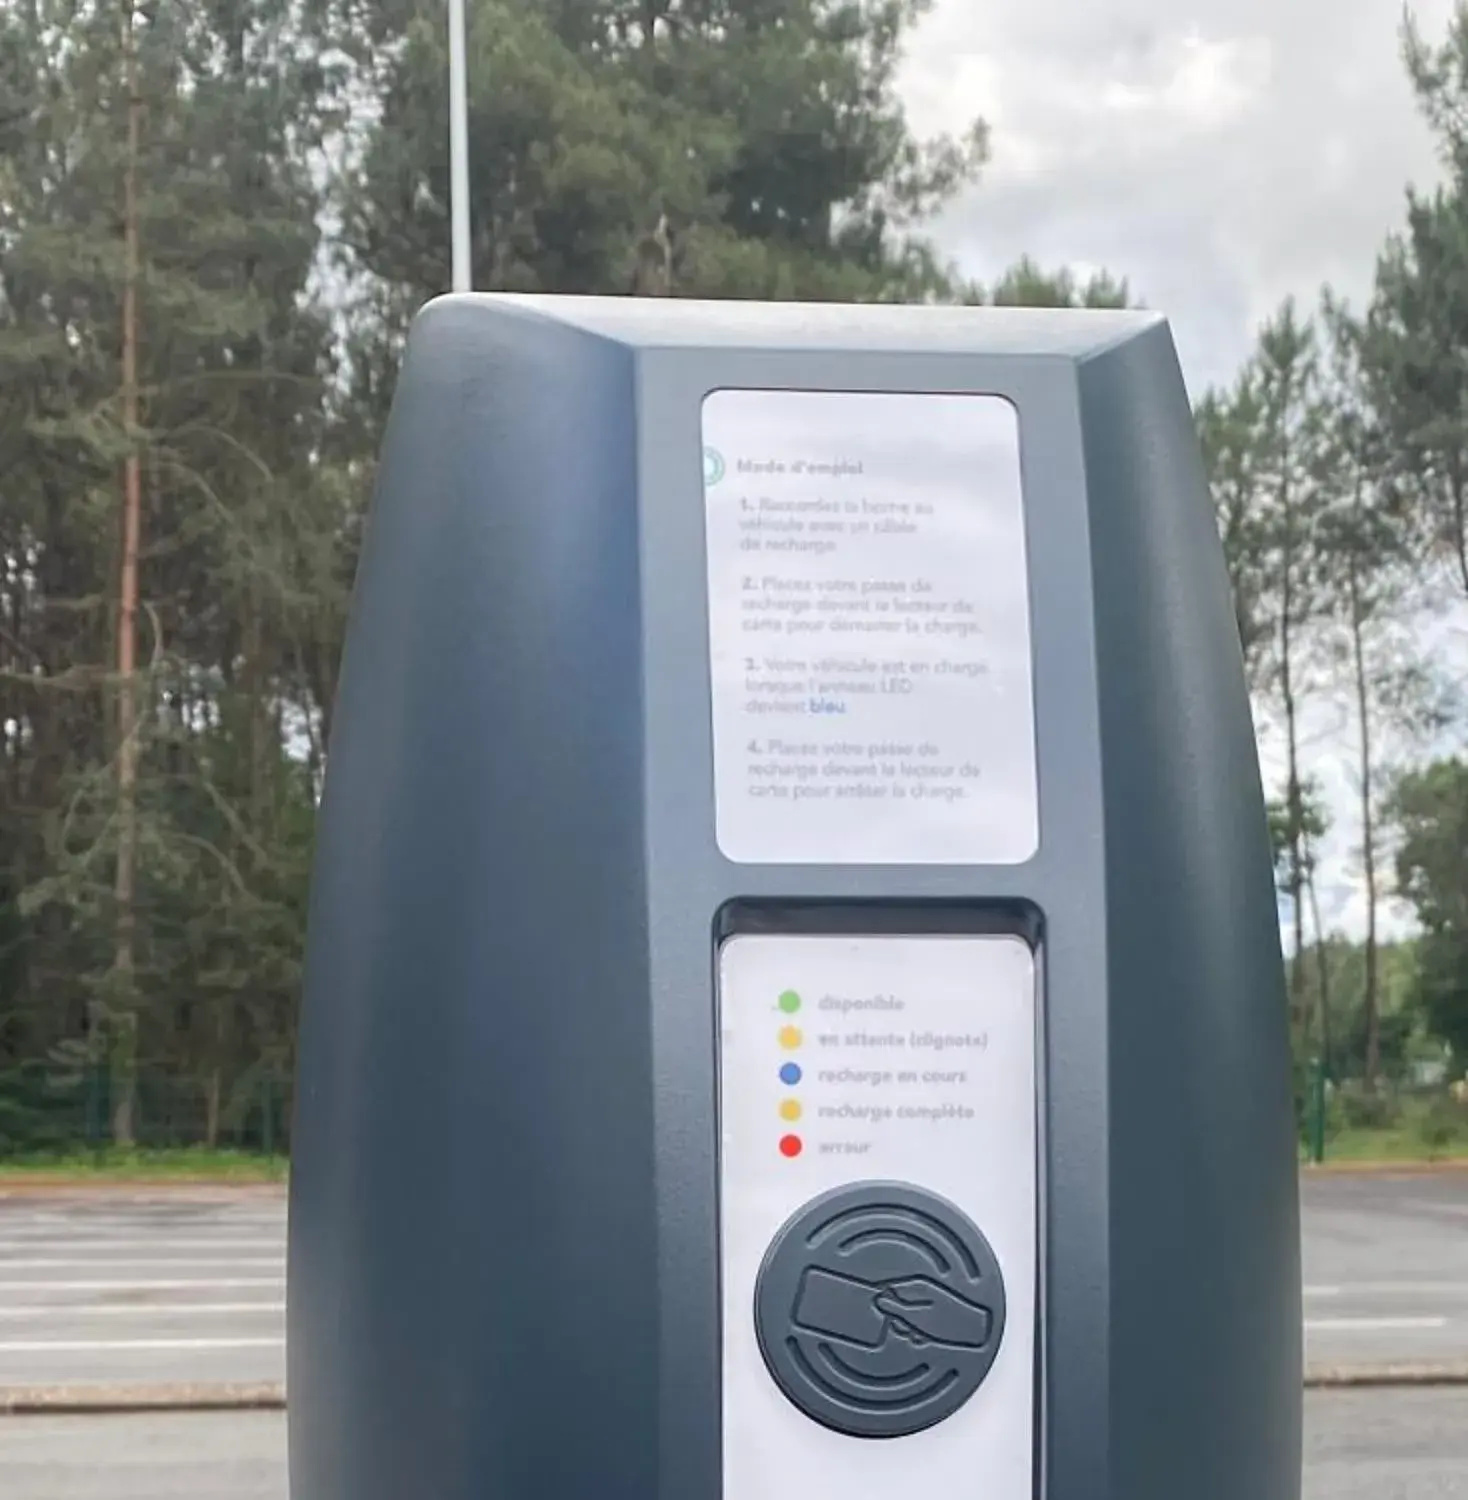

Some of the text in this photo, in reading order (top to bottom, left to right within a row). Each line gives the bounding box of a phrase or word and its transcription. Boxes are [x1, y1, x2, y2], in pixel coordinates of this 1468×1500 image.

[818, 992, 906, 1015] disponible
[818, 1033, 839, 1047] en
[845, 1029, 906, 1048] attente
[818, 1068, 967, 1087] recharge en cours
[818, 1101, 975, 1124] recharge complète
[818, 1141, 872, 1155] erreur
